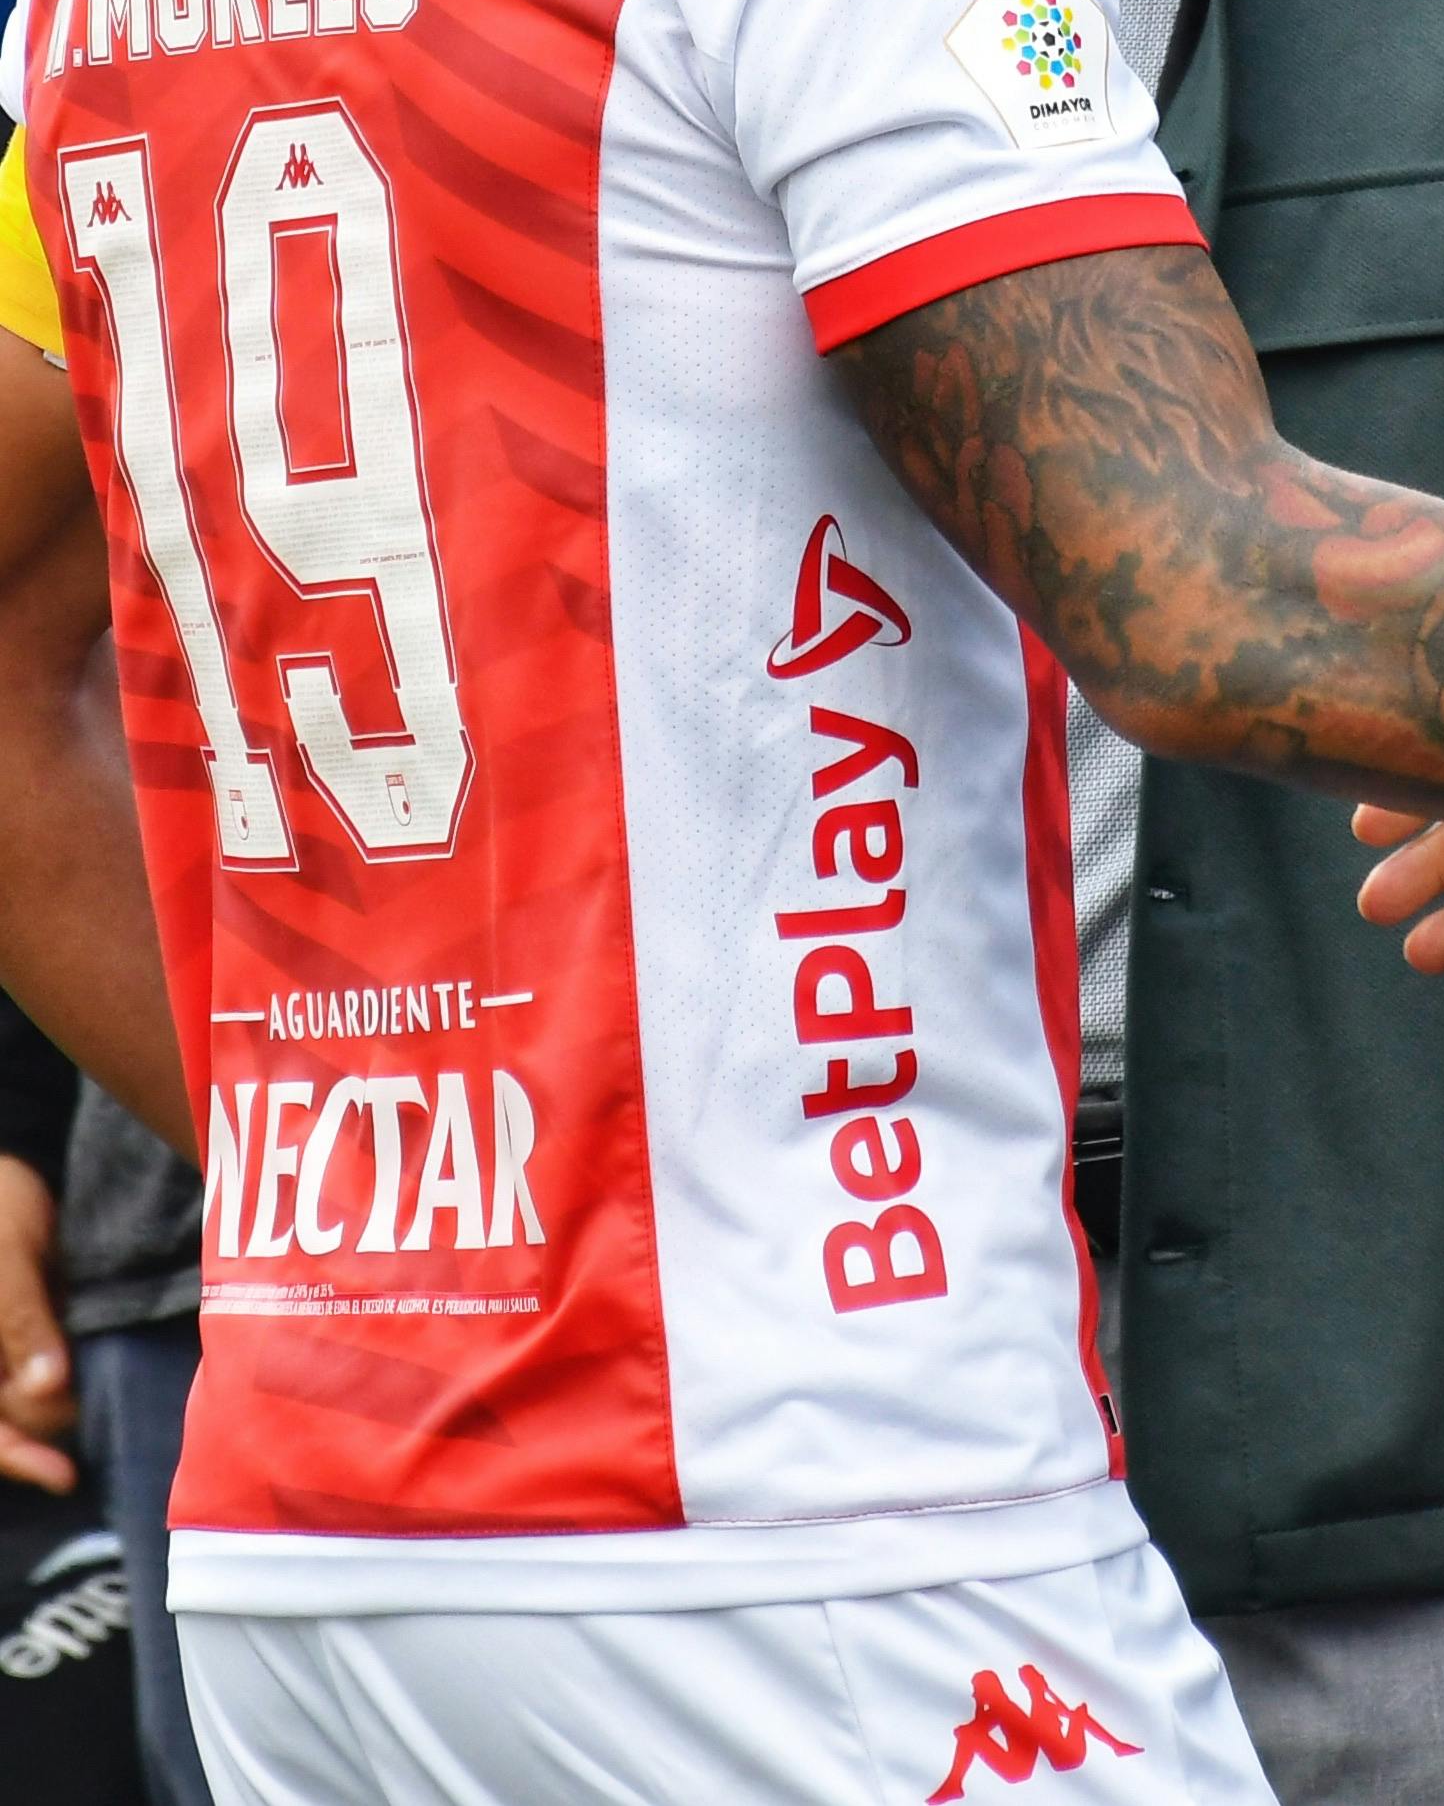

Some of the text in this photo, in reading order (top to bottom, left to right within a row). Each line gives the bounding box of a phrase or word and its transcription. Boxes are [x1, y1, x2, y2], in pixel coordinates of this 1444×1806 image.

[1030, 97, 1093, 120] DIMAYOR
[57, 96, 476, 872] 19
[268, 981, 476, 1041] AGUARDIENTE
[776, 705, 948, 1315] BetPlay
[202, 1069, 547, 1258] NECTAR
